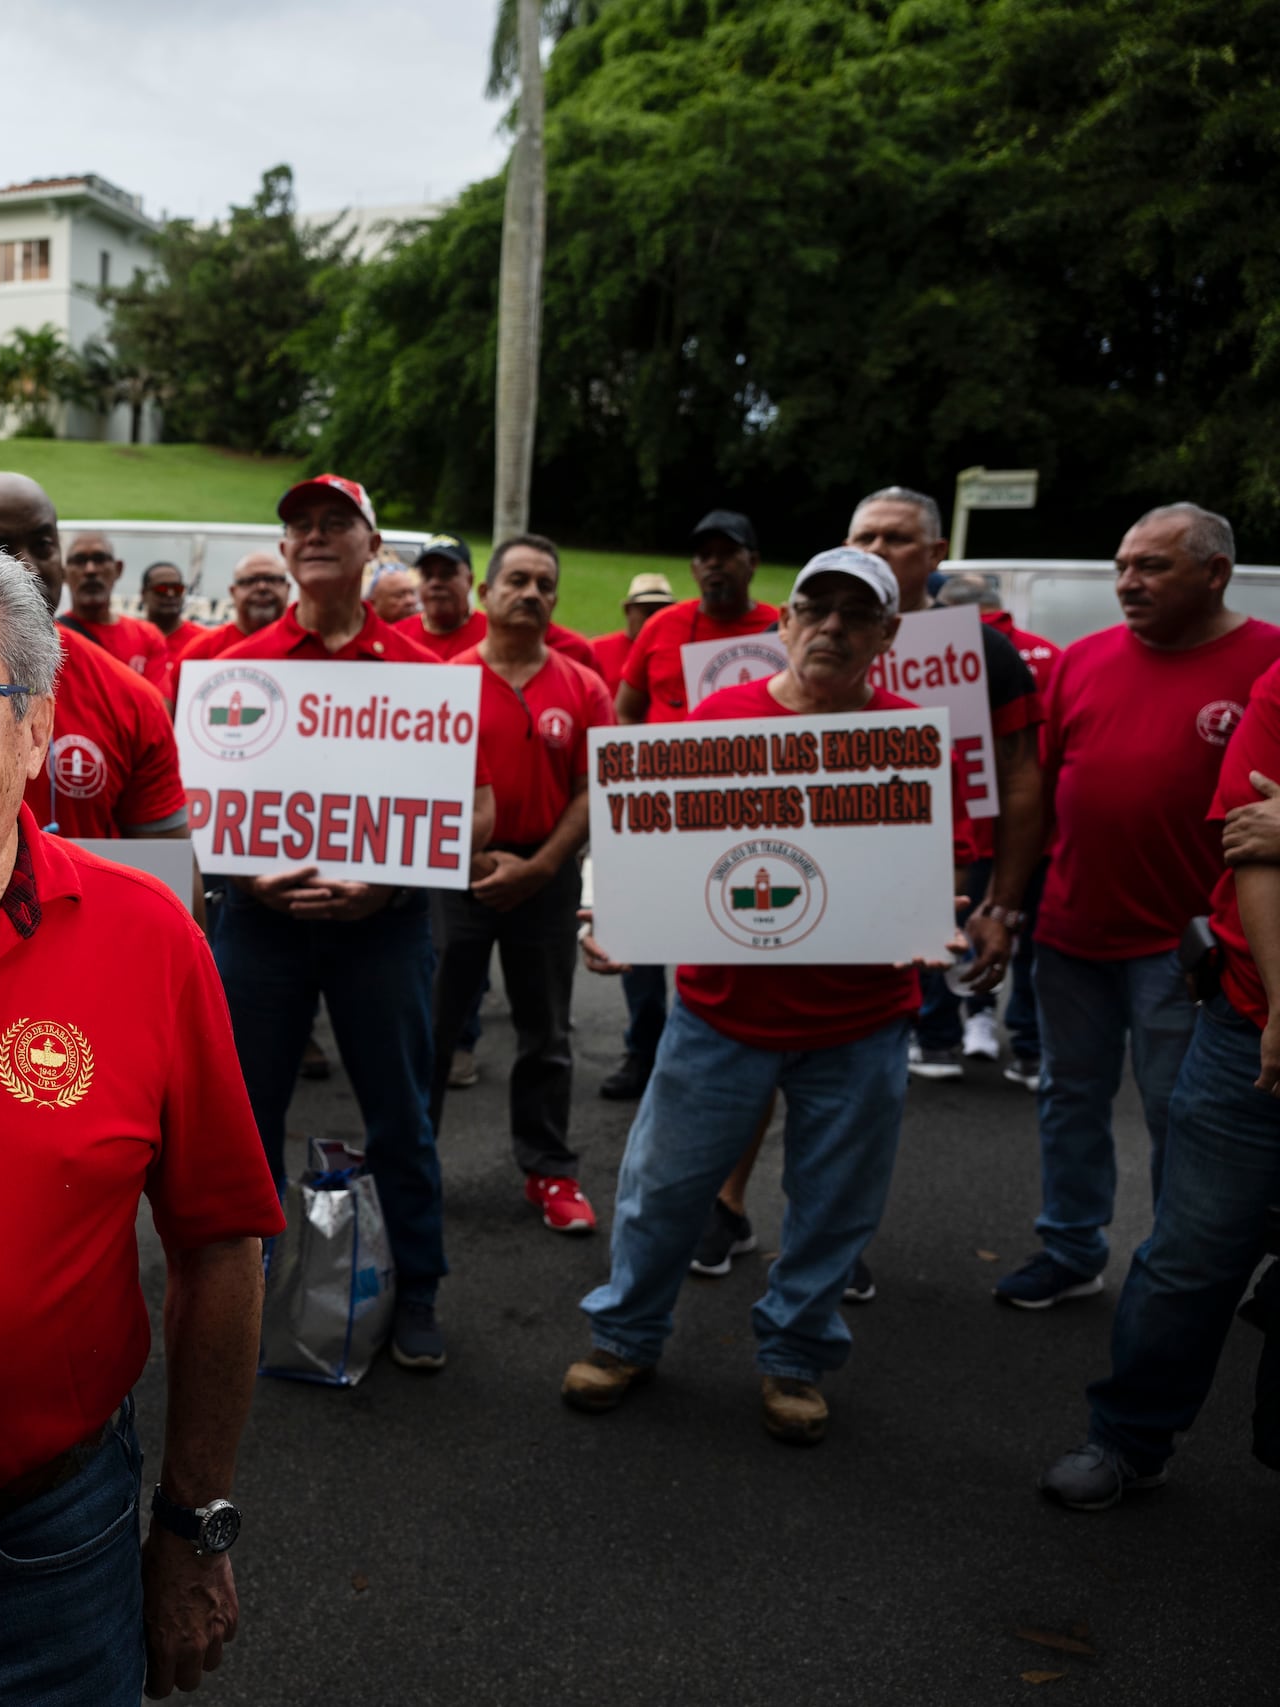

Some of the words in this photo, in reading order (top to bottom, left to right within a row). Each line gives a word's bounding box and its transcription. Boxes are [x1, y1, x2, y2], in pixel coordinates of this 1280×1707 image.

[867, 643, 982, 692] dicato
[297, 693, 474, 745] Sindicato
[597, 742, 635, 787] ¡SE
[636, 734, 768, 781] ACABARON
[771, 730, 819, 775] LAS
[821, 724, 942, 773] EXCUSAS
[185, 788, 463, 870] PRESENTE
[607, 793, 625, 834] Y
[627, 791, 672, 834] LOS
[673, 785, 806, 833] EMBUSTES
[806, 774, 933, 828] TAMBIÉN!
[17, 1031, 33, 1074] SINDICATO
[31, 1024, 44, 1034] DE
[45, 1024, 78, 1079] TRABAJADORES
[39, 1067, 57, 1077] 1942
